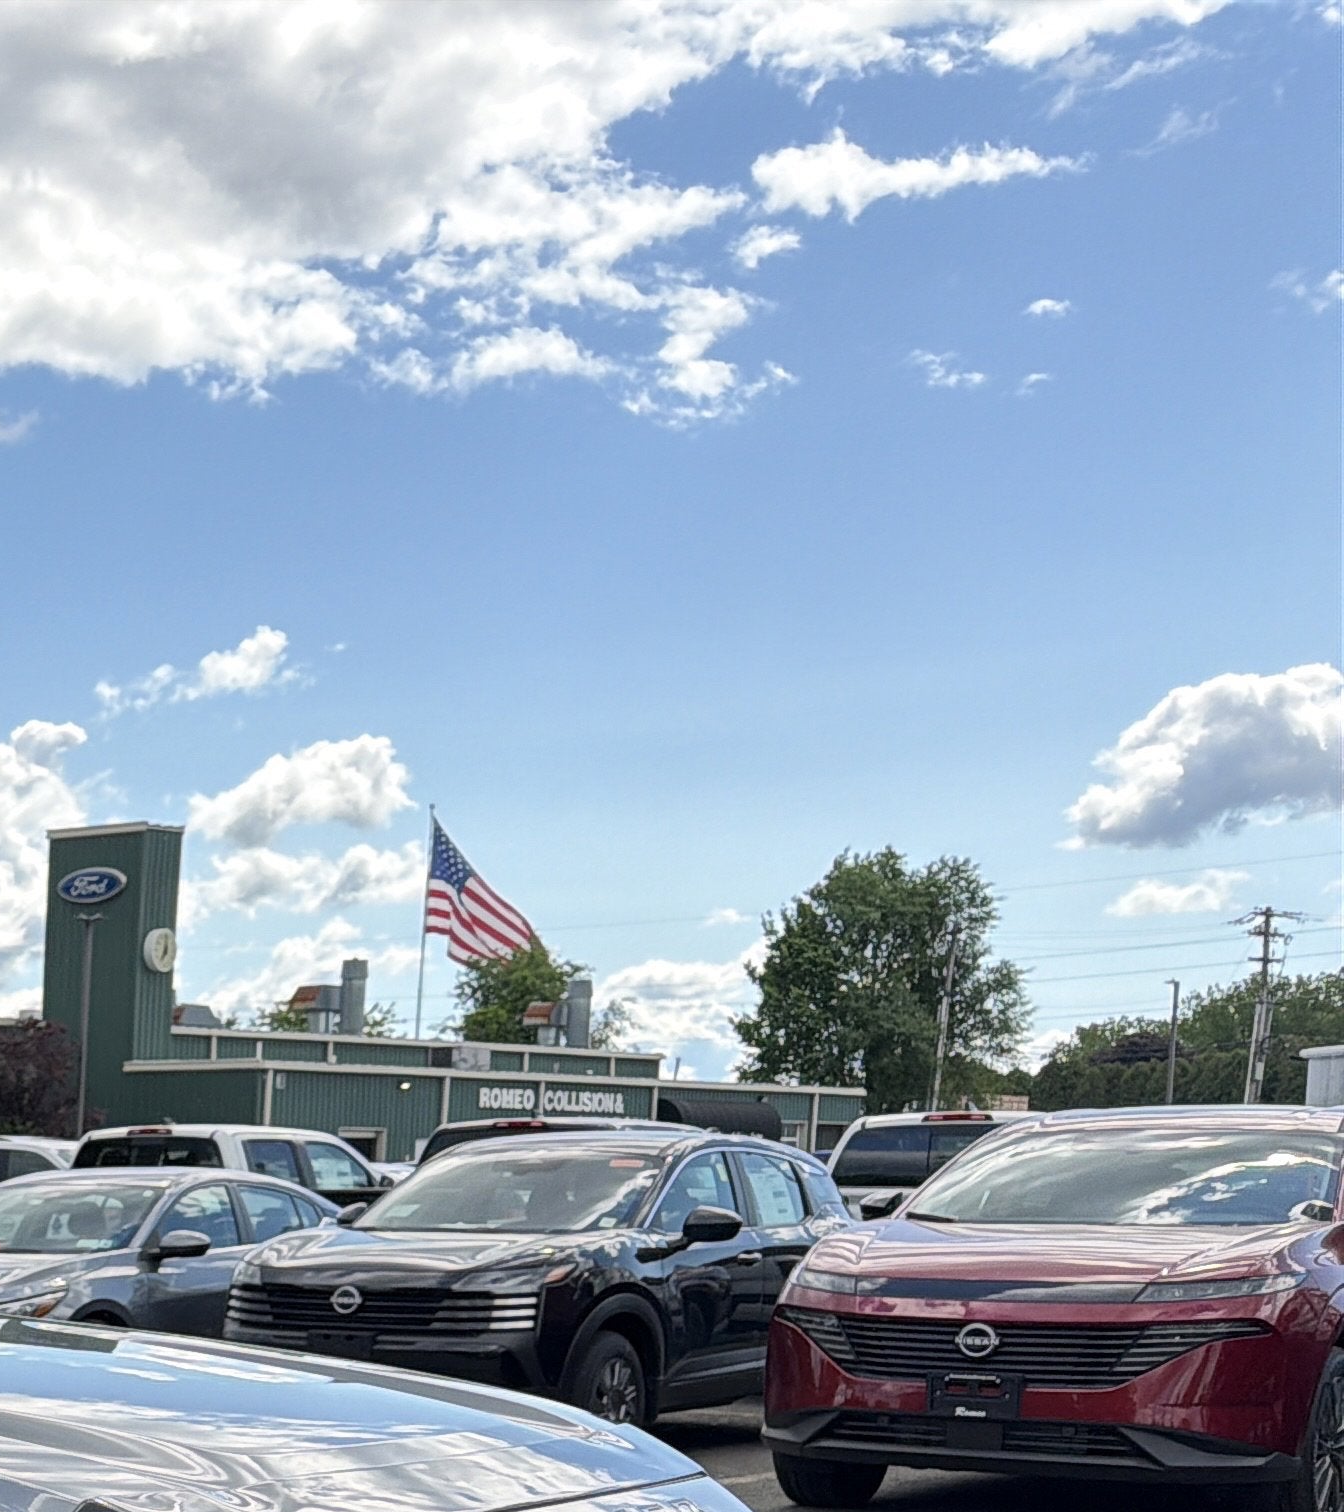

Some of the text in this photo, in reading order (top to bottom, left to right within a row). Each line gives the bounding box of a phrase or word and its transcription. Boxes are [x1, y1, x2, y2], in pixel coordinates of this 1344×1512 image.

[70, 875, 109, 896] Ford
[479, 1087, 535, 1110] ROMEO
[544, 1090, 615, 1113] COLLISION
